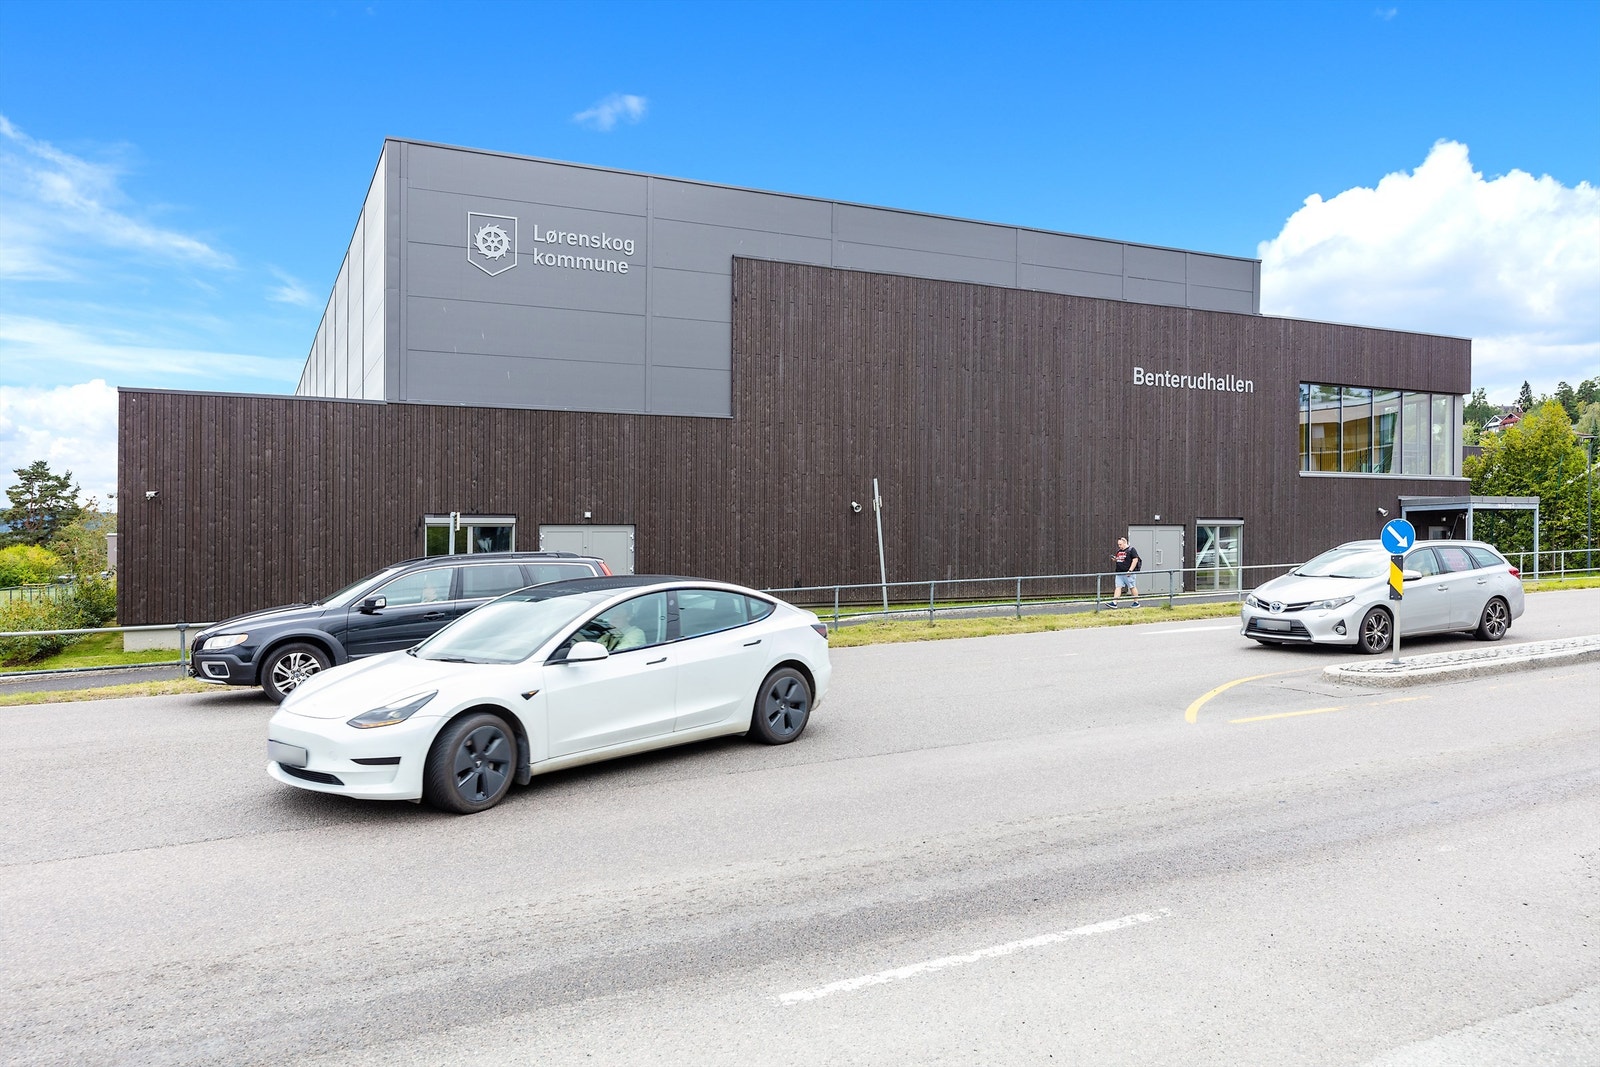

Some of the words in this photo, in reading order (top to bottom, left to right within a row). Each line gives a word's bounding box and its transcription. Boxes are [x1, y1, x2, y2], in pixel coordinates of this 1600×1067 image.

[533, 224, 636, 256] Lørenskog
[533, 247, 630, 274] kommune
[1133, 366, 1255, 393] Benterudhallen
